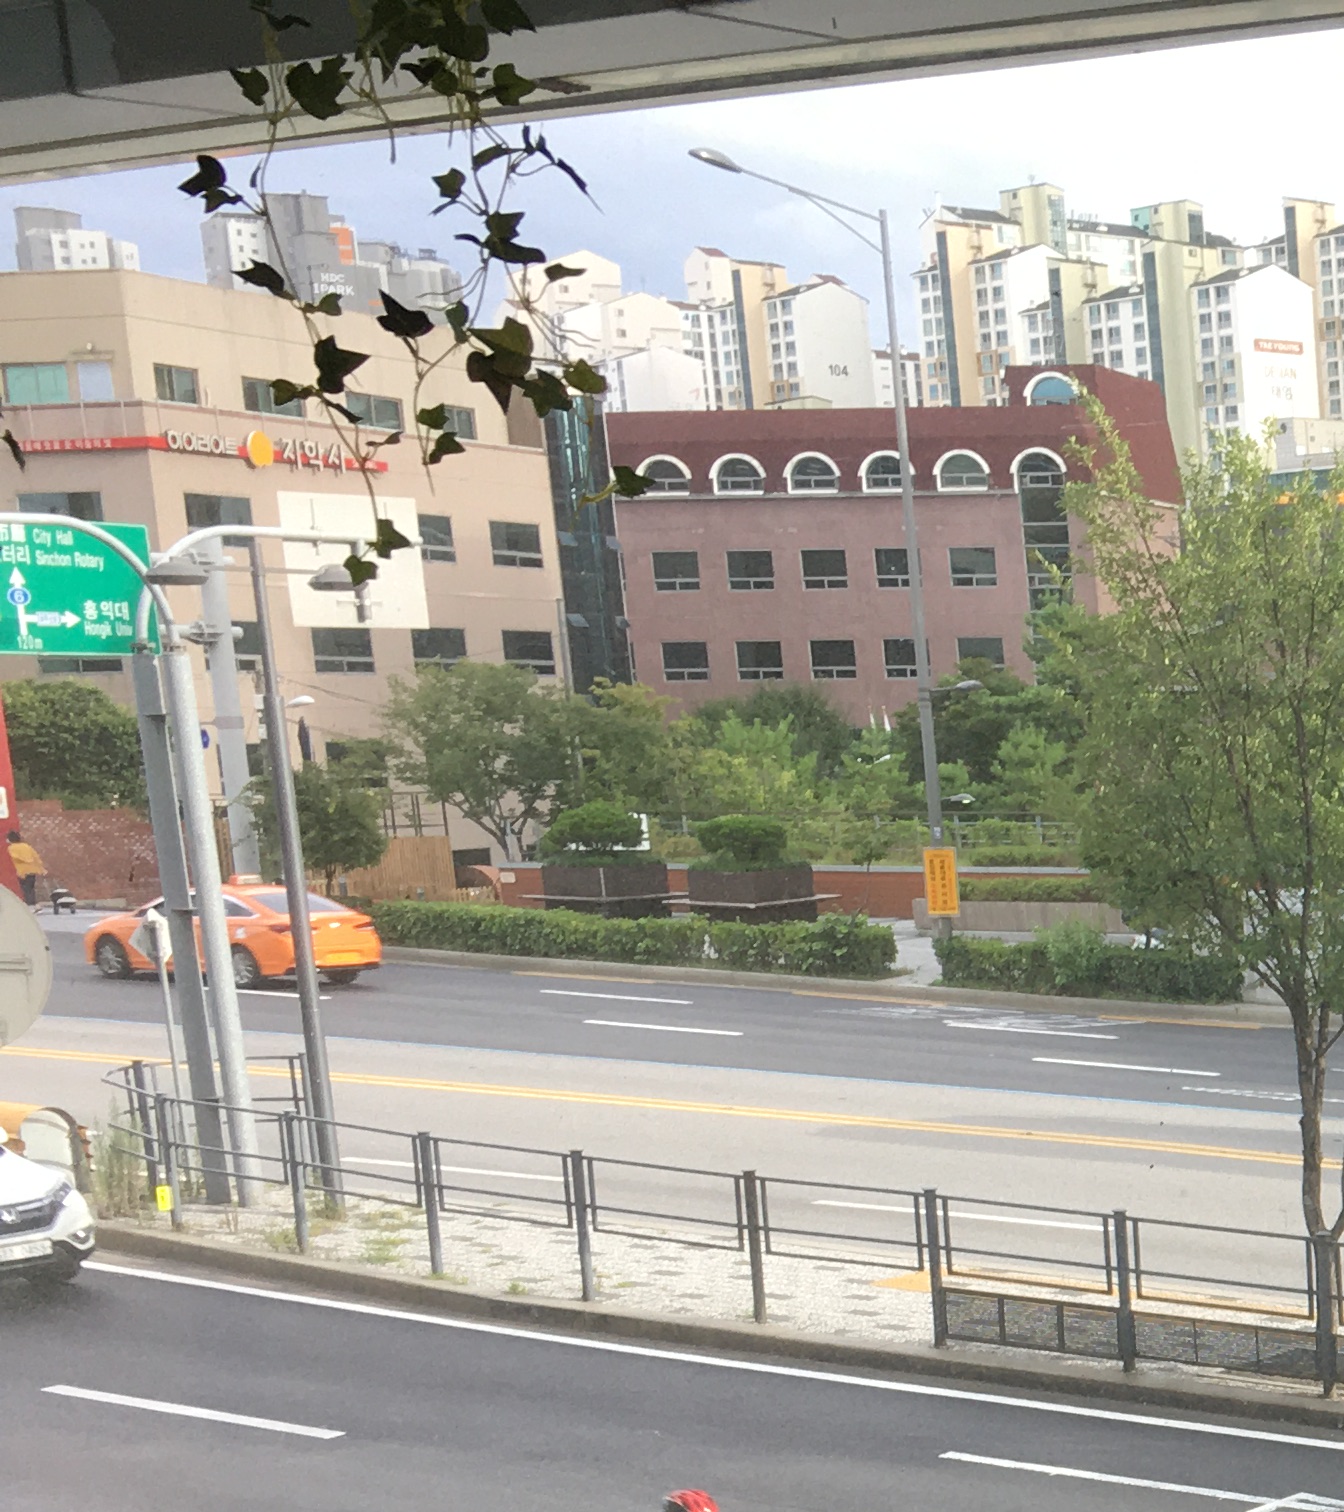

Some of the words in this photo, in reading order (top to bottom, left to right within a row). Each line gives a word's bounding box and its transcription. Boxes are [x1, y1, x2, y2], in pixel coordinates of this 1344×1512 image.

[828, 364, 849, 376] 104
[33, 528, 52, 547] City
[56, 530, 74, 546] Hall
[83, 599, 130, 621] 홍익대
